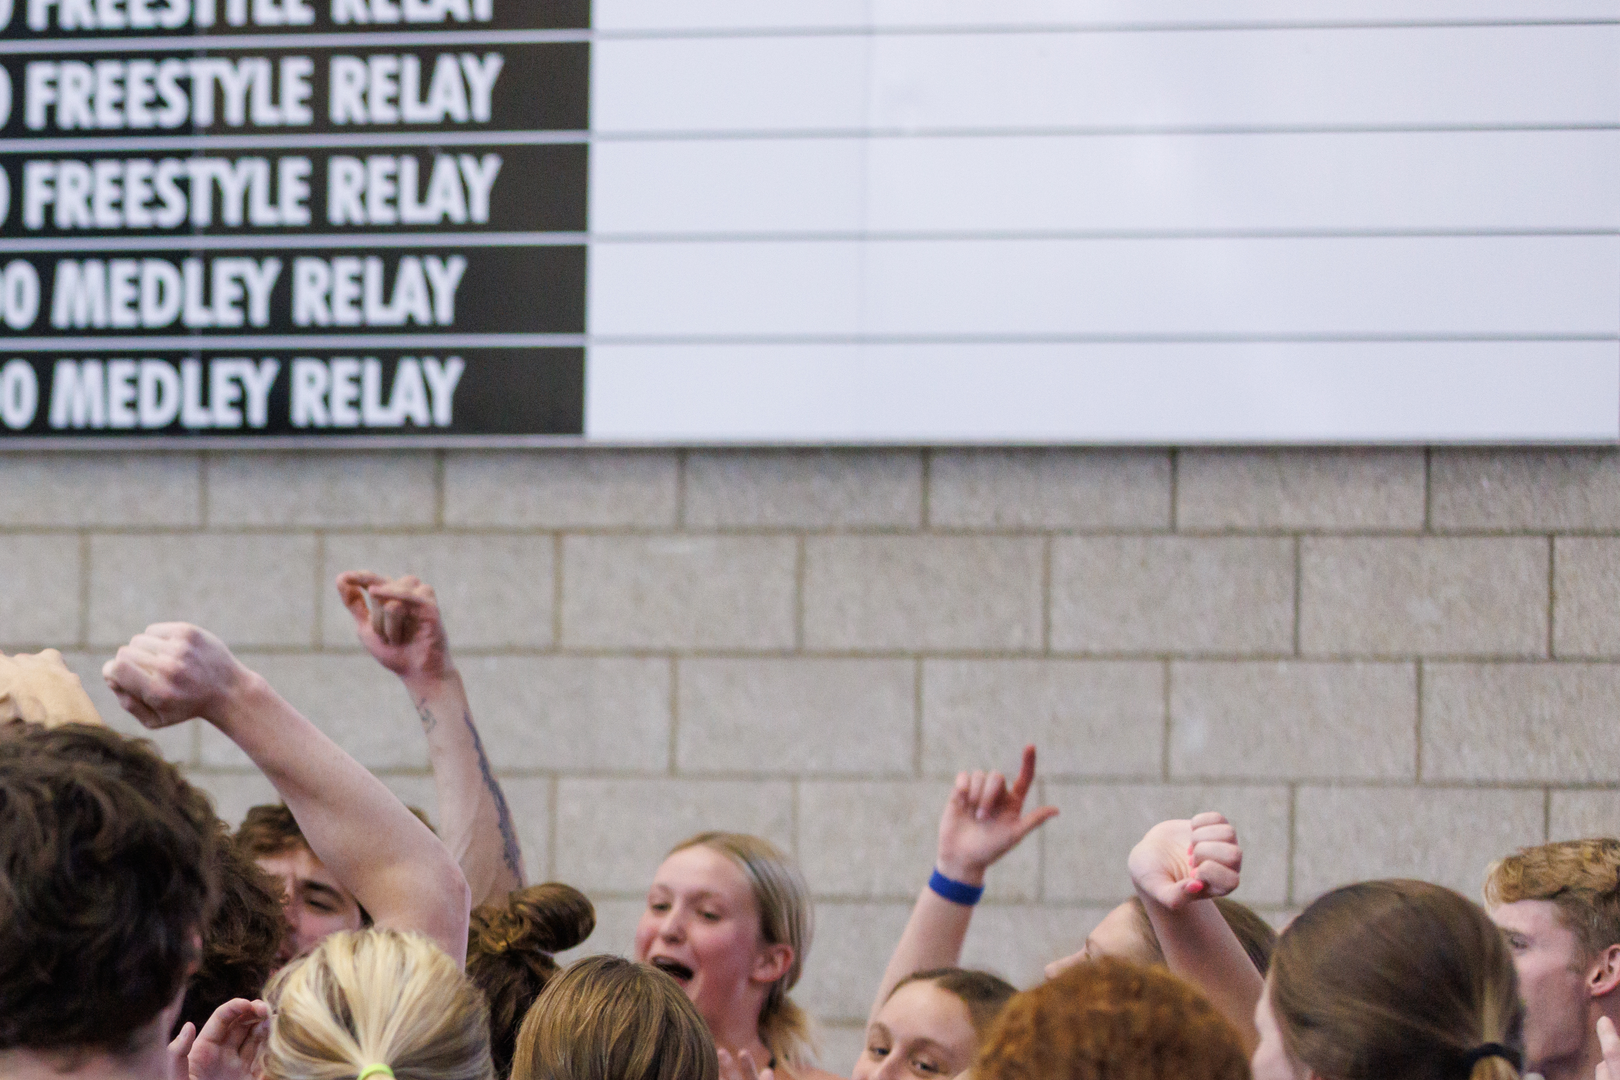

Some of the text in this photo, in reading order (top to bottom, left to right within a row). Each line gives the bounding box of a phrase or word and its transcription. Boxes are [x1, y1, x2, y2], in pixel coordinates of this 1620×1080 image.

[26, 57, 314, 129] FREESTYLE
[329, 53, 503, 124] RELAY
[24, 157, 312, 229] FREESTYLE
[328, 154, 501, 225] RELAY
[51, 258, 281, 328] MEDLEY
[293, 256, 466, 326] RELAY
[50, 358, 279, 428] MEDLEY
[291, 357, 464, 426] RELAY
